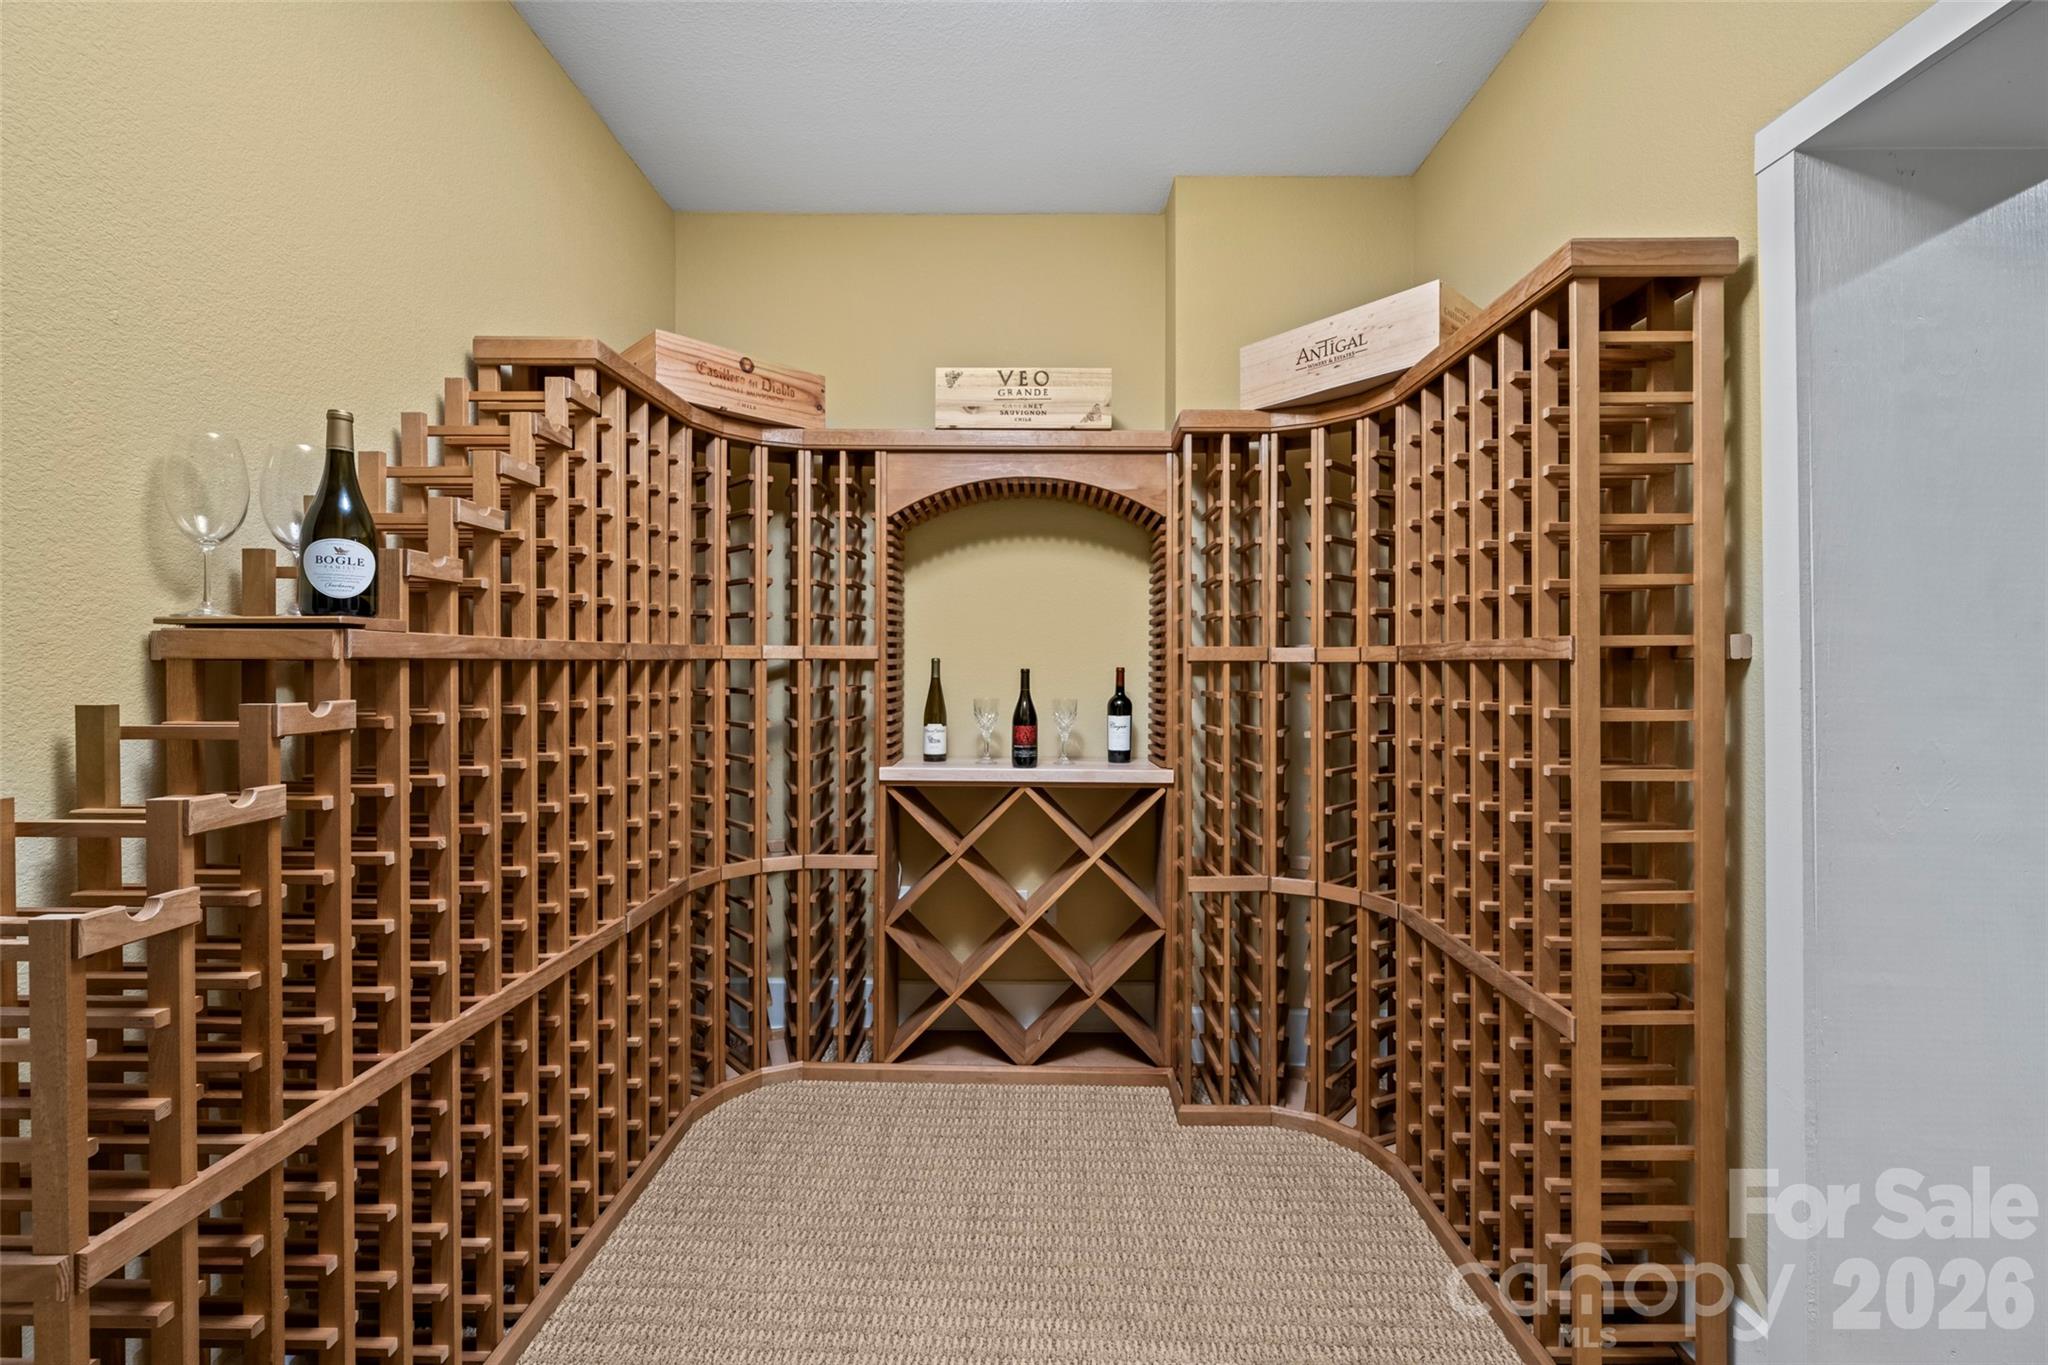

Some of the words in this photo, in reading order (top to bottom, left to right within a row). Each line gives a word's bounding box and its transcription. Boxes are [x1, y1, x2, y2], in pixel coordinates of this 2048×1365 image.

[997, 370, 1050, 387] VEO
[762, 376, 796, 398] Diablo
[997, 388, 1049, 397] GRANDE
[315, 554, 365, 567] BOGLE
